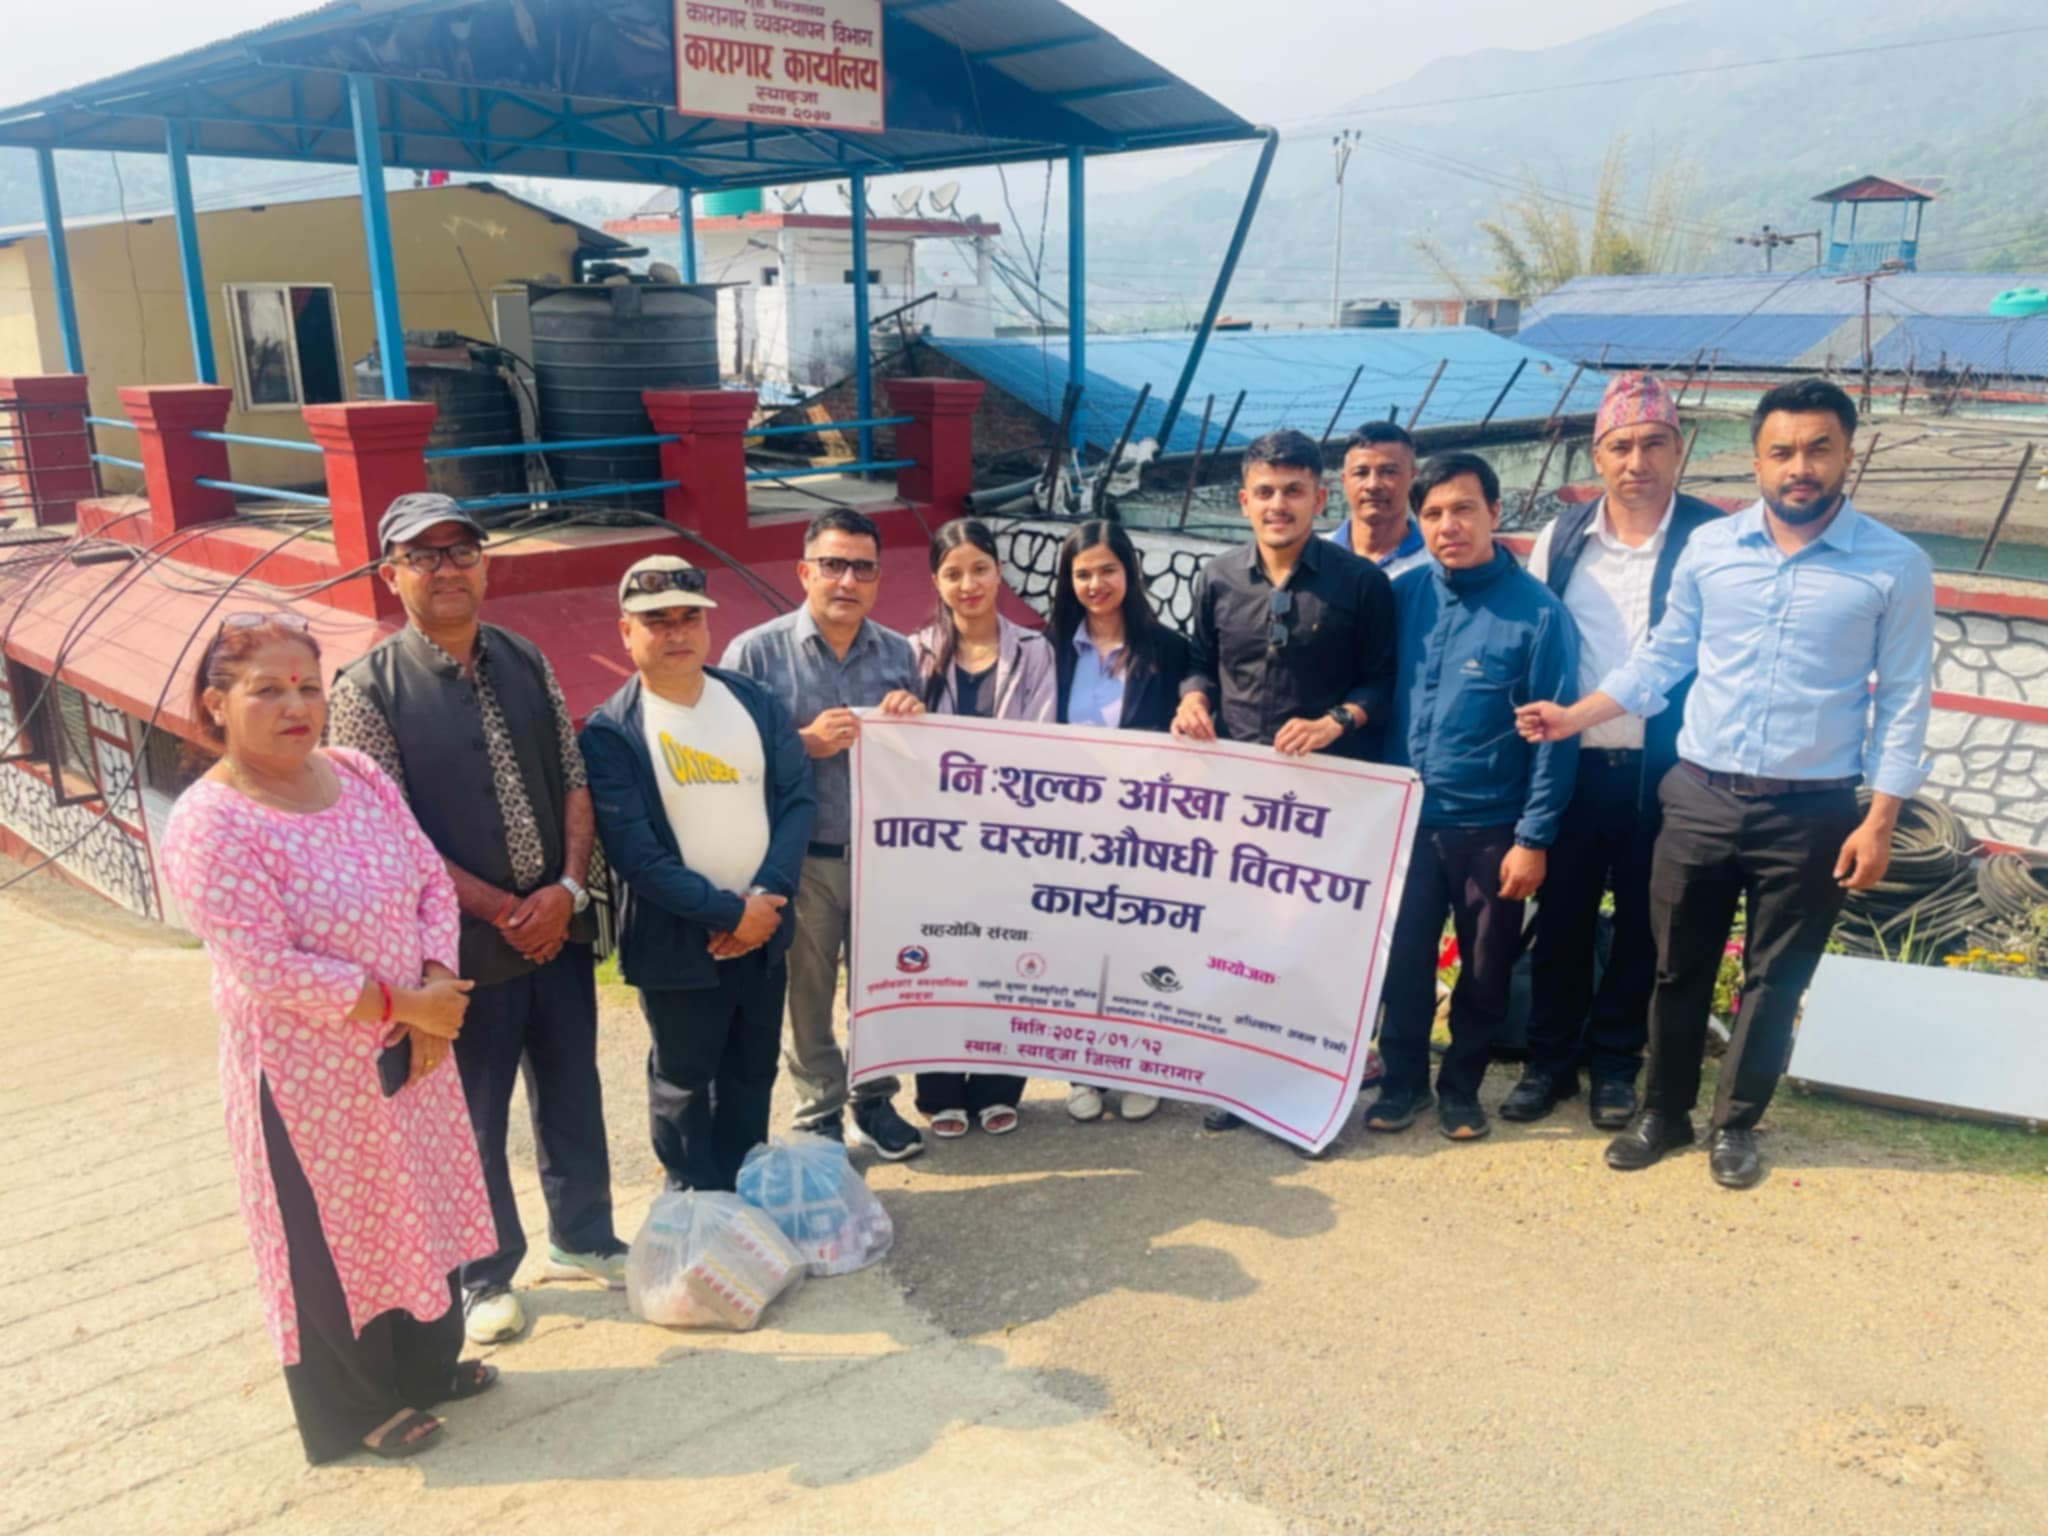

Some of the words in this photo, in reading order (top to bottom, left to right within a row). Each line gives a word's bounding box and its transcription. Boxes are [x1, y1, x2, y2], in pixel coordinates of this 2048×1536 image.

[686, 2, 747, 30] कारागार
[752, 13, 826, 42] व्यवस्थापन
[831, 19, 873, 47] विभाग
[683, 34, 774, 80] कारागार
[783, 47, 880, 91] कार्यालय
[1118, 772, 1230, 822] आँखा
[1241, 789, 1331, 838] जाँच
[874, 817, 967, 852] पावर
[1229, 843, 1371, 911] वितरण
[1031, 882, 1206, 934] कार्यक्रम
[1085, 1047, 1133, 1070] जिल्ला
[1138, 1058, 1205, 1085] कारागार
